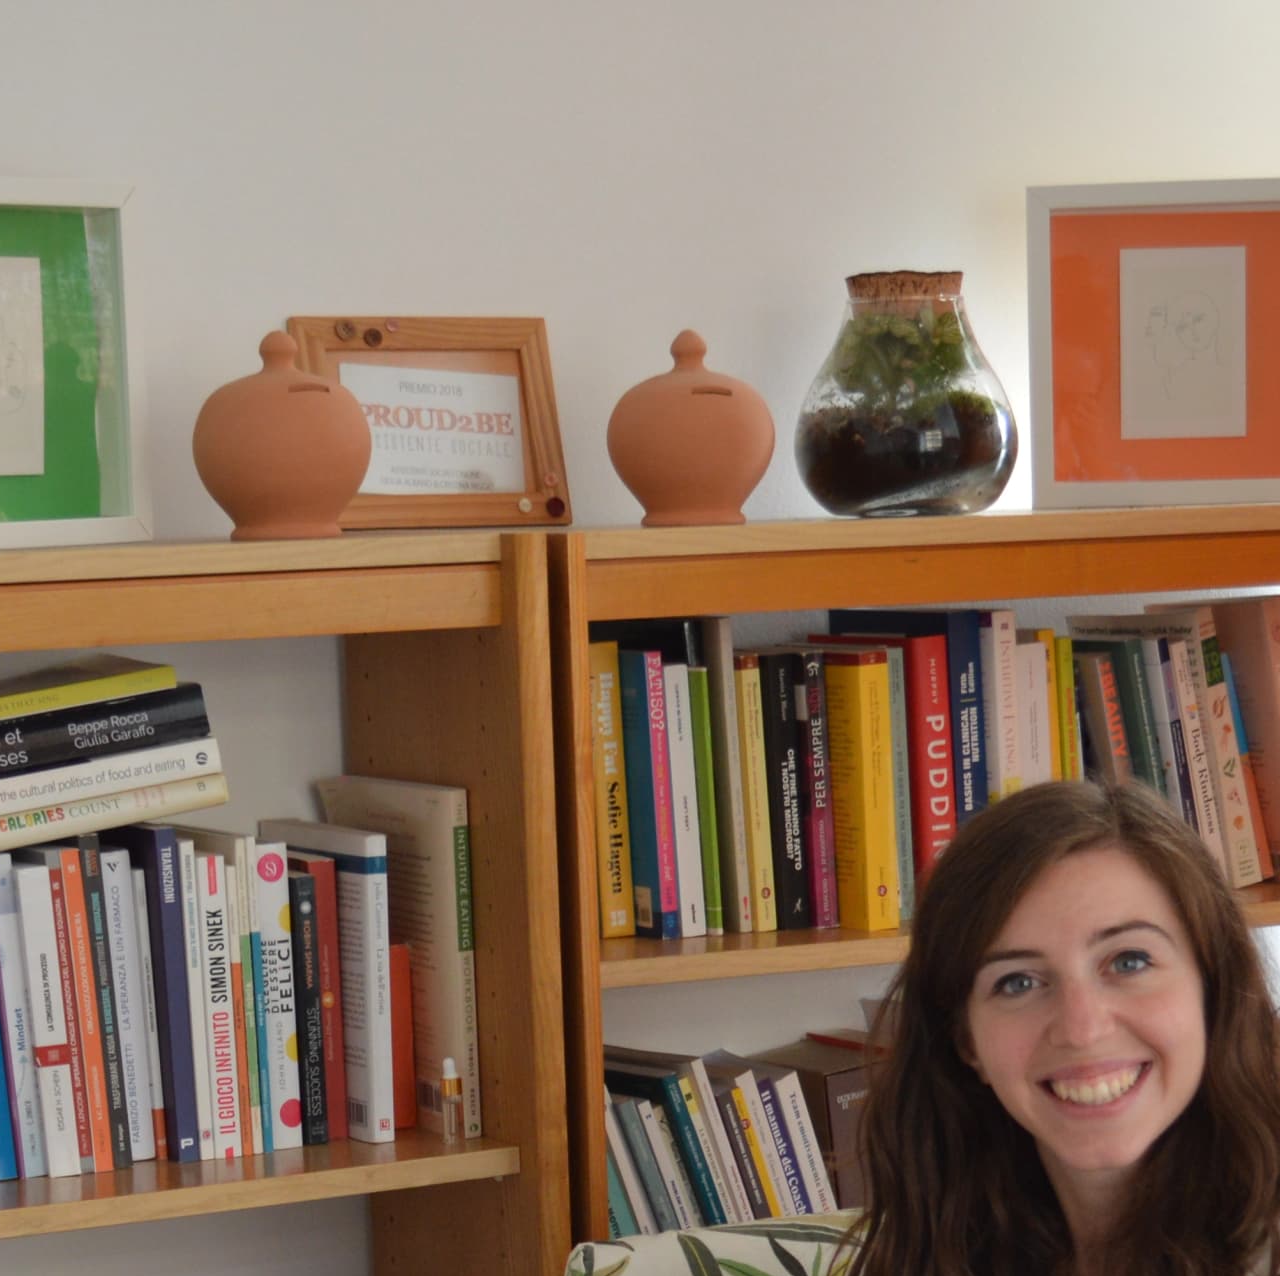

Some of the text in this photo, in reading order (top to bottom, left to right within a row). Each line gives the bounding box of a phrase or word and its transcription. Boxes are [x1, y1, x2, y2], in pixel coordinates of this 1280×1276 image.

[959, 672, 967, 693] Fifth
[966, 661, 975, 692] Edition
[3, 726, 23, 747] et
[67, 710, 149, 737] Beppe Rocca
[73, 723, 155, 750] Giulia Garaffo
[597, 672, 618, 775] Happy Fat
[810, 717, 825, 776] SEMPRE
[969, 706, 979, 762] NUTRITION
[0, 756, 186, 803] the cultural politics of food and eating
[960, 707, 972, 810] BASICS IN CLINICAL
[1188, 728, 1218, 835] Body Kindness
[67, 797, 122, 819] COUNT
[780, 768, 790, 805] NOSTRI
[786, 748, 802, 870] CHE FINE HANNO FATTO
[814, 778, 827, 807] PER
[454, 829, 467, 896] INTUITIVE
[604, 781, 624, 894] Sofie Hagen
[159, 846, 175, 903] TRANSIZIONI
[109, 884, 123, 934] FARMACO
[458, 899, 469, 948] EATING
[206, 908, 227, 1003] SIMON SINEK
[267, 939, 280, 1013] DI ESSERE
[301, 919, 314, 989] ROBIN SHARMA
[116, 963, 131, 1015] SPERANZA
[12, 1007, 27, 1051] Mindset
[122, 1017, 133, 1030] LA
[211, 1011, 236, 1134] IL GIOCO INFINITO
[304, 1007, 323, 1116] STUNNING SUCCESS
[122, 1042, 142, 1143] FABRIZIO BENEDETTI
[761, 1102, 791, 1156] manuale
[779, 1155, 796, 1176] del
[784, 1175, 809, 1216] Coach
